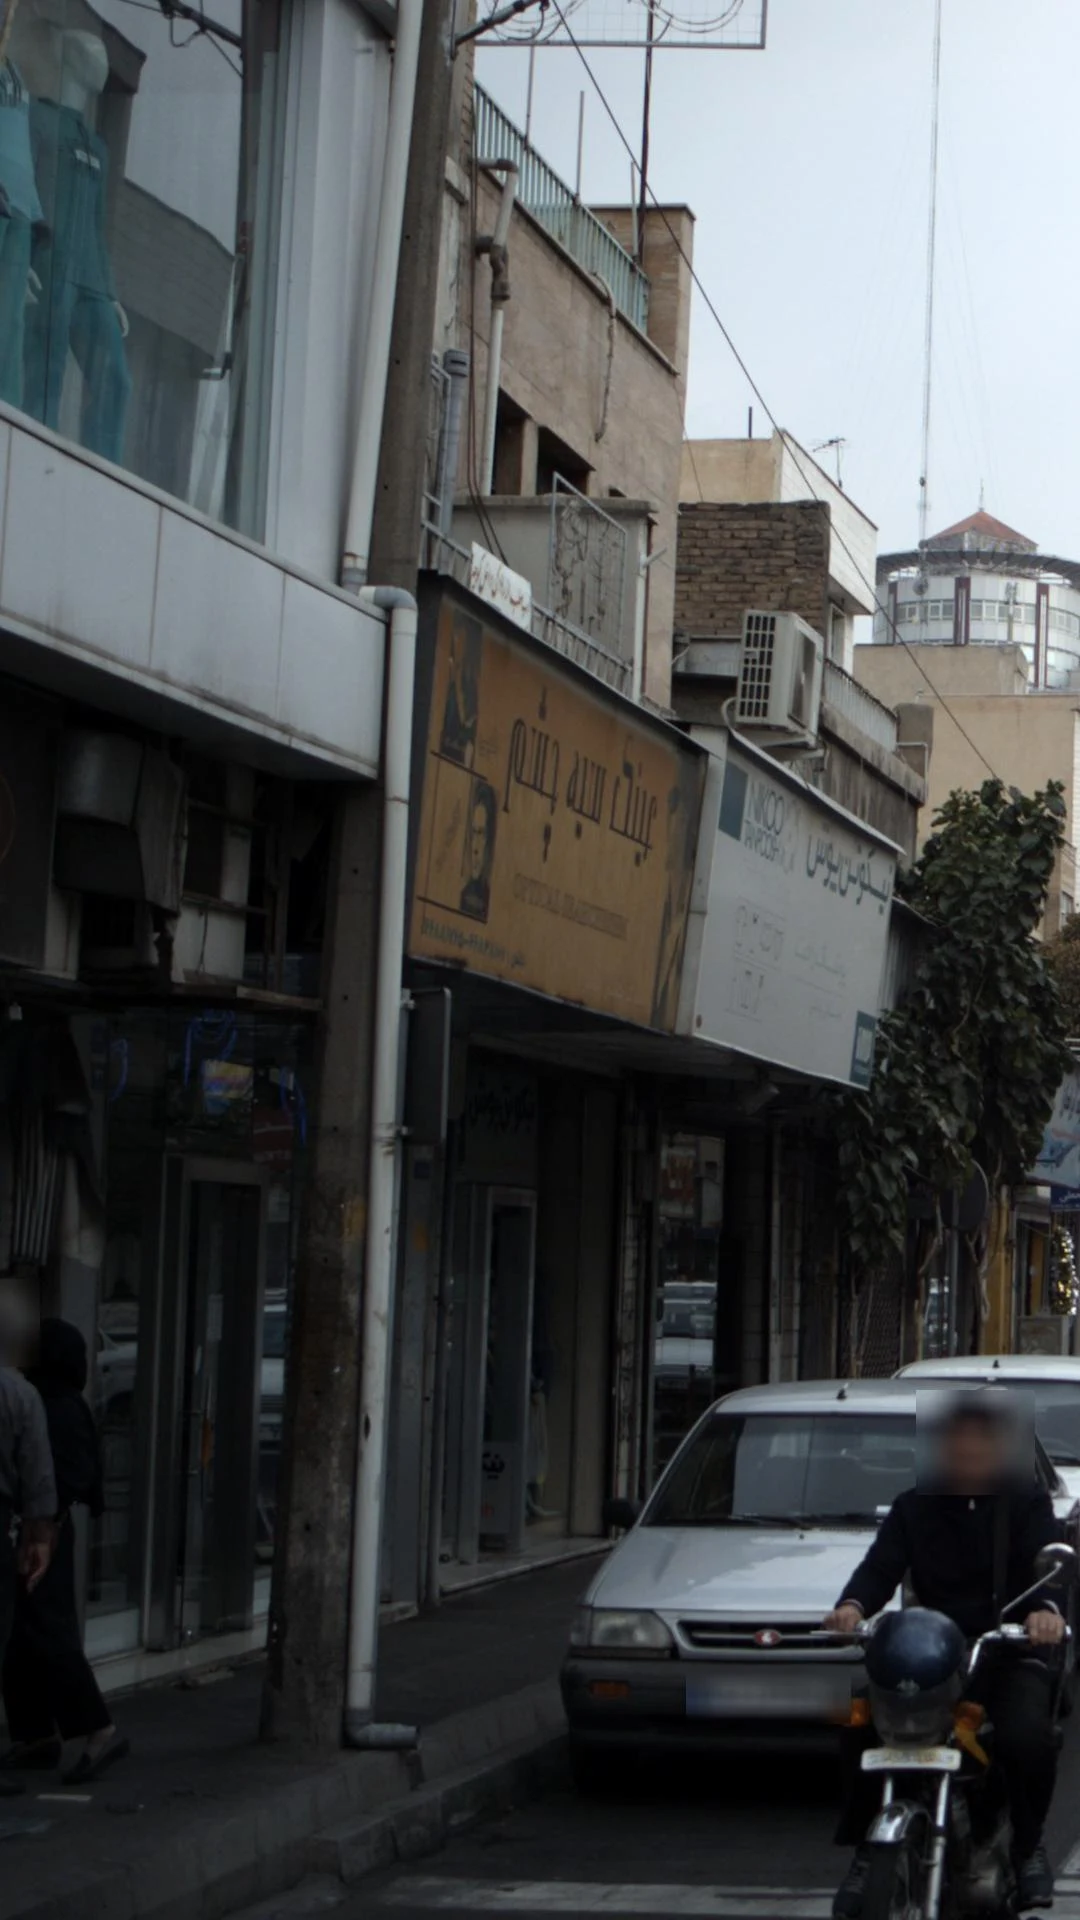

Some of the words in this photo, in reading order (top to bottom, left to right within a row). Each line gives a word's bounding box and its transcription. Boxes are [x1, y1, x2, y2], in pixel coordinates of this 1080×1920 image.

[502, 687, 559, 863] چشم
[566, 751, 607, 840] سیه
[609, 734, 658, 867] عینک
[746, 778, 785, 835] NIKOO
